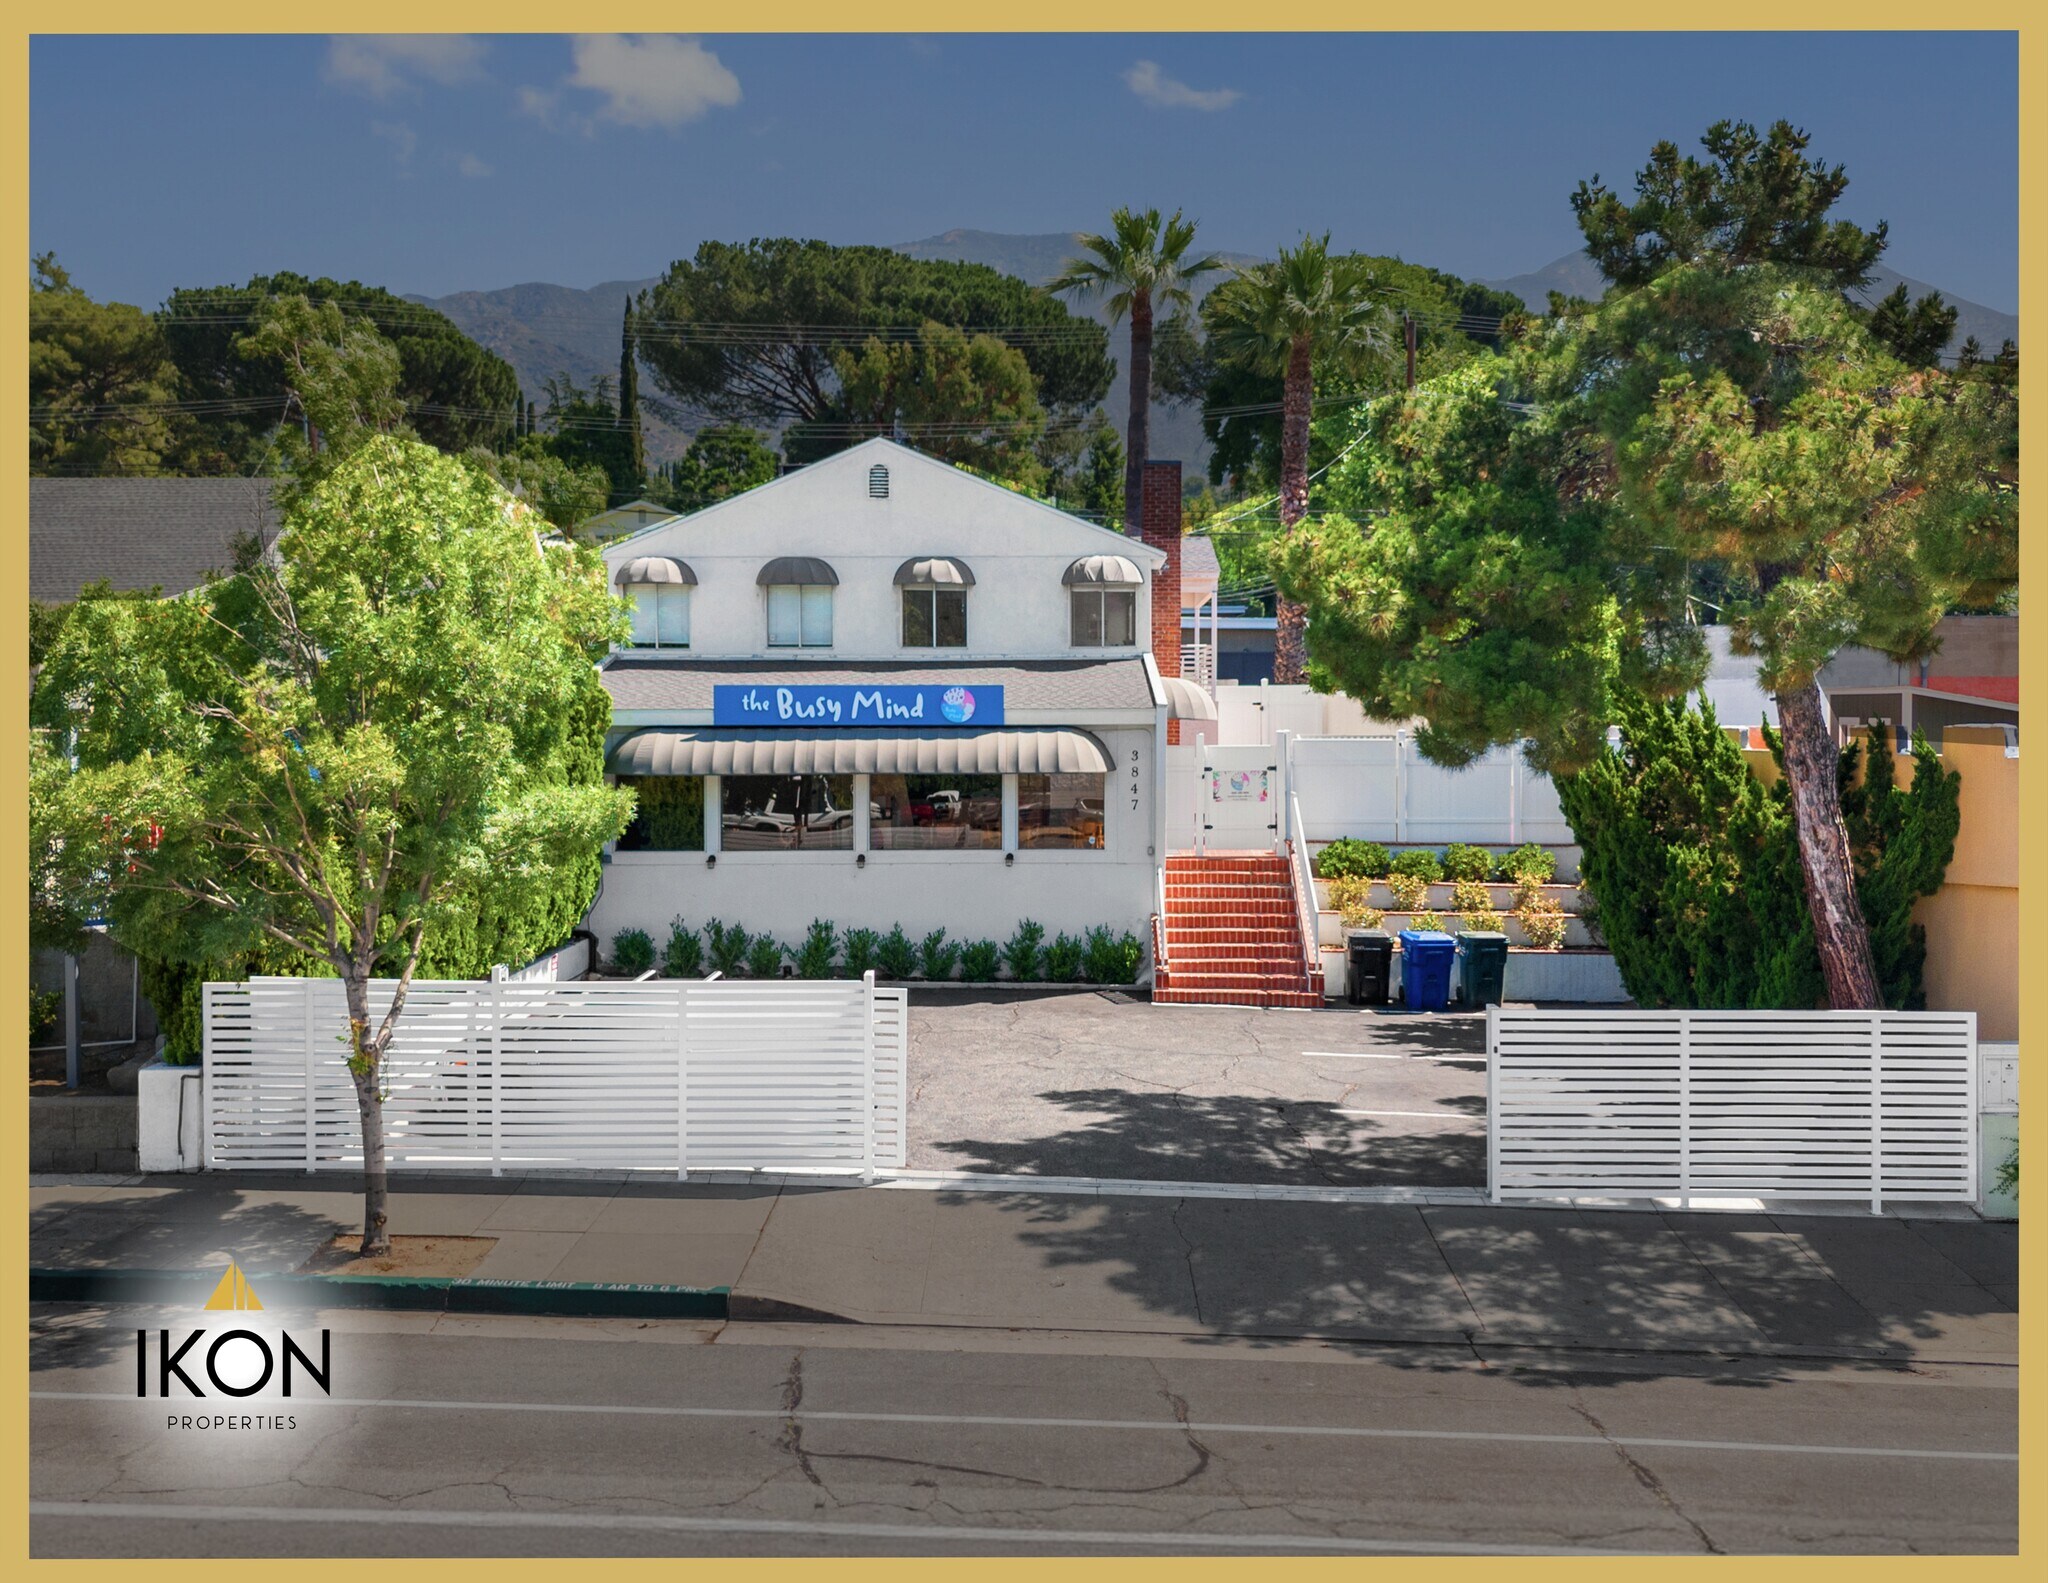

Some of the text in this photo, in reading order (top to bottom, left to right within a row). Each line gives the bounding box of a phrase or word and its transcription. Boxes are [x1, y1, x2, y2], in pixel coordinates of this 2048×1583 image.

[742, 689, 769, 711] the
[776, 687, 842, 722] Busy
[851, 691, 923, 719] Mind
[1130, 750, 1139, 811] 3847
[476, 1279, 531, 1288] MINUTE
[535, 1280, 577, 1289] LIMIT
[608, 1283, 630, 1291] AM
[637, 1284, 654, 1292] TO
